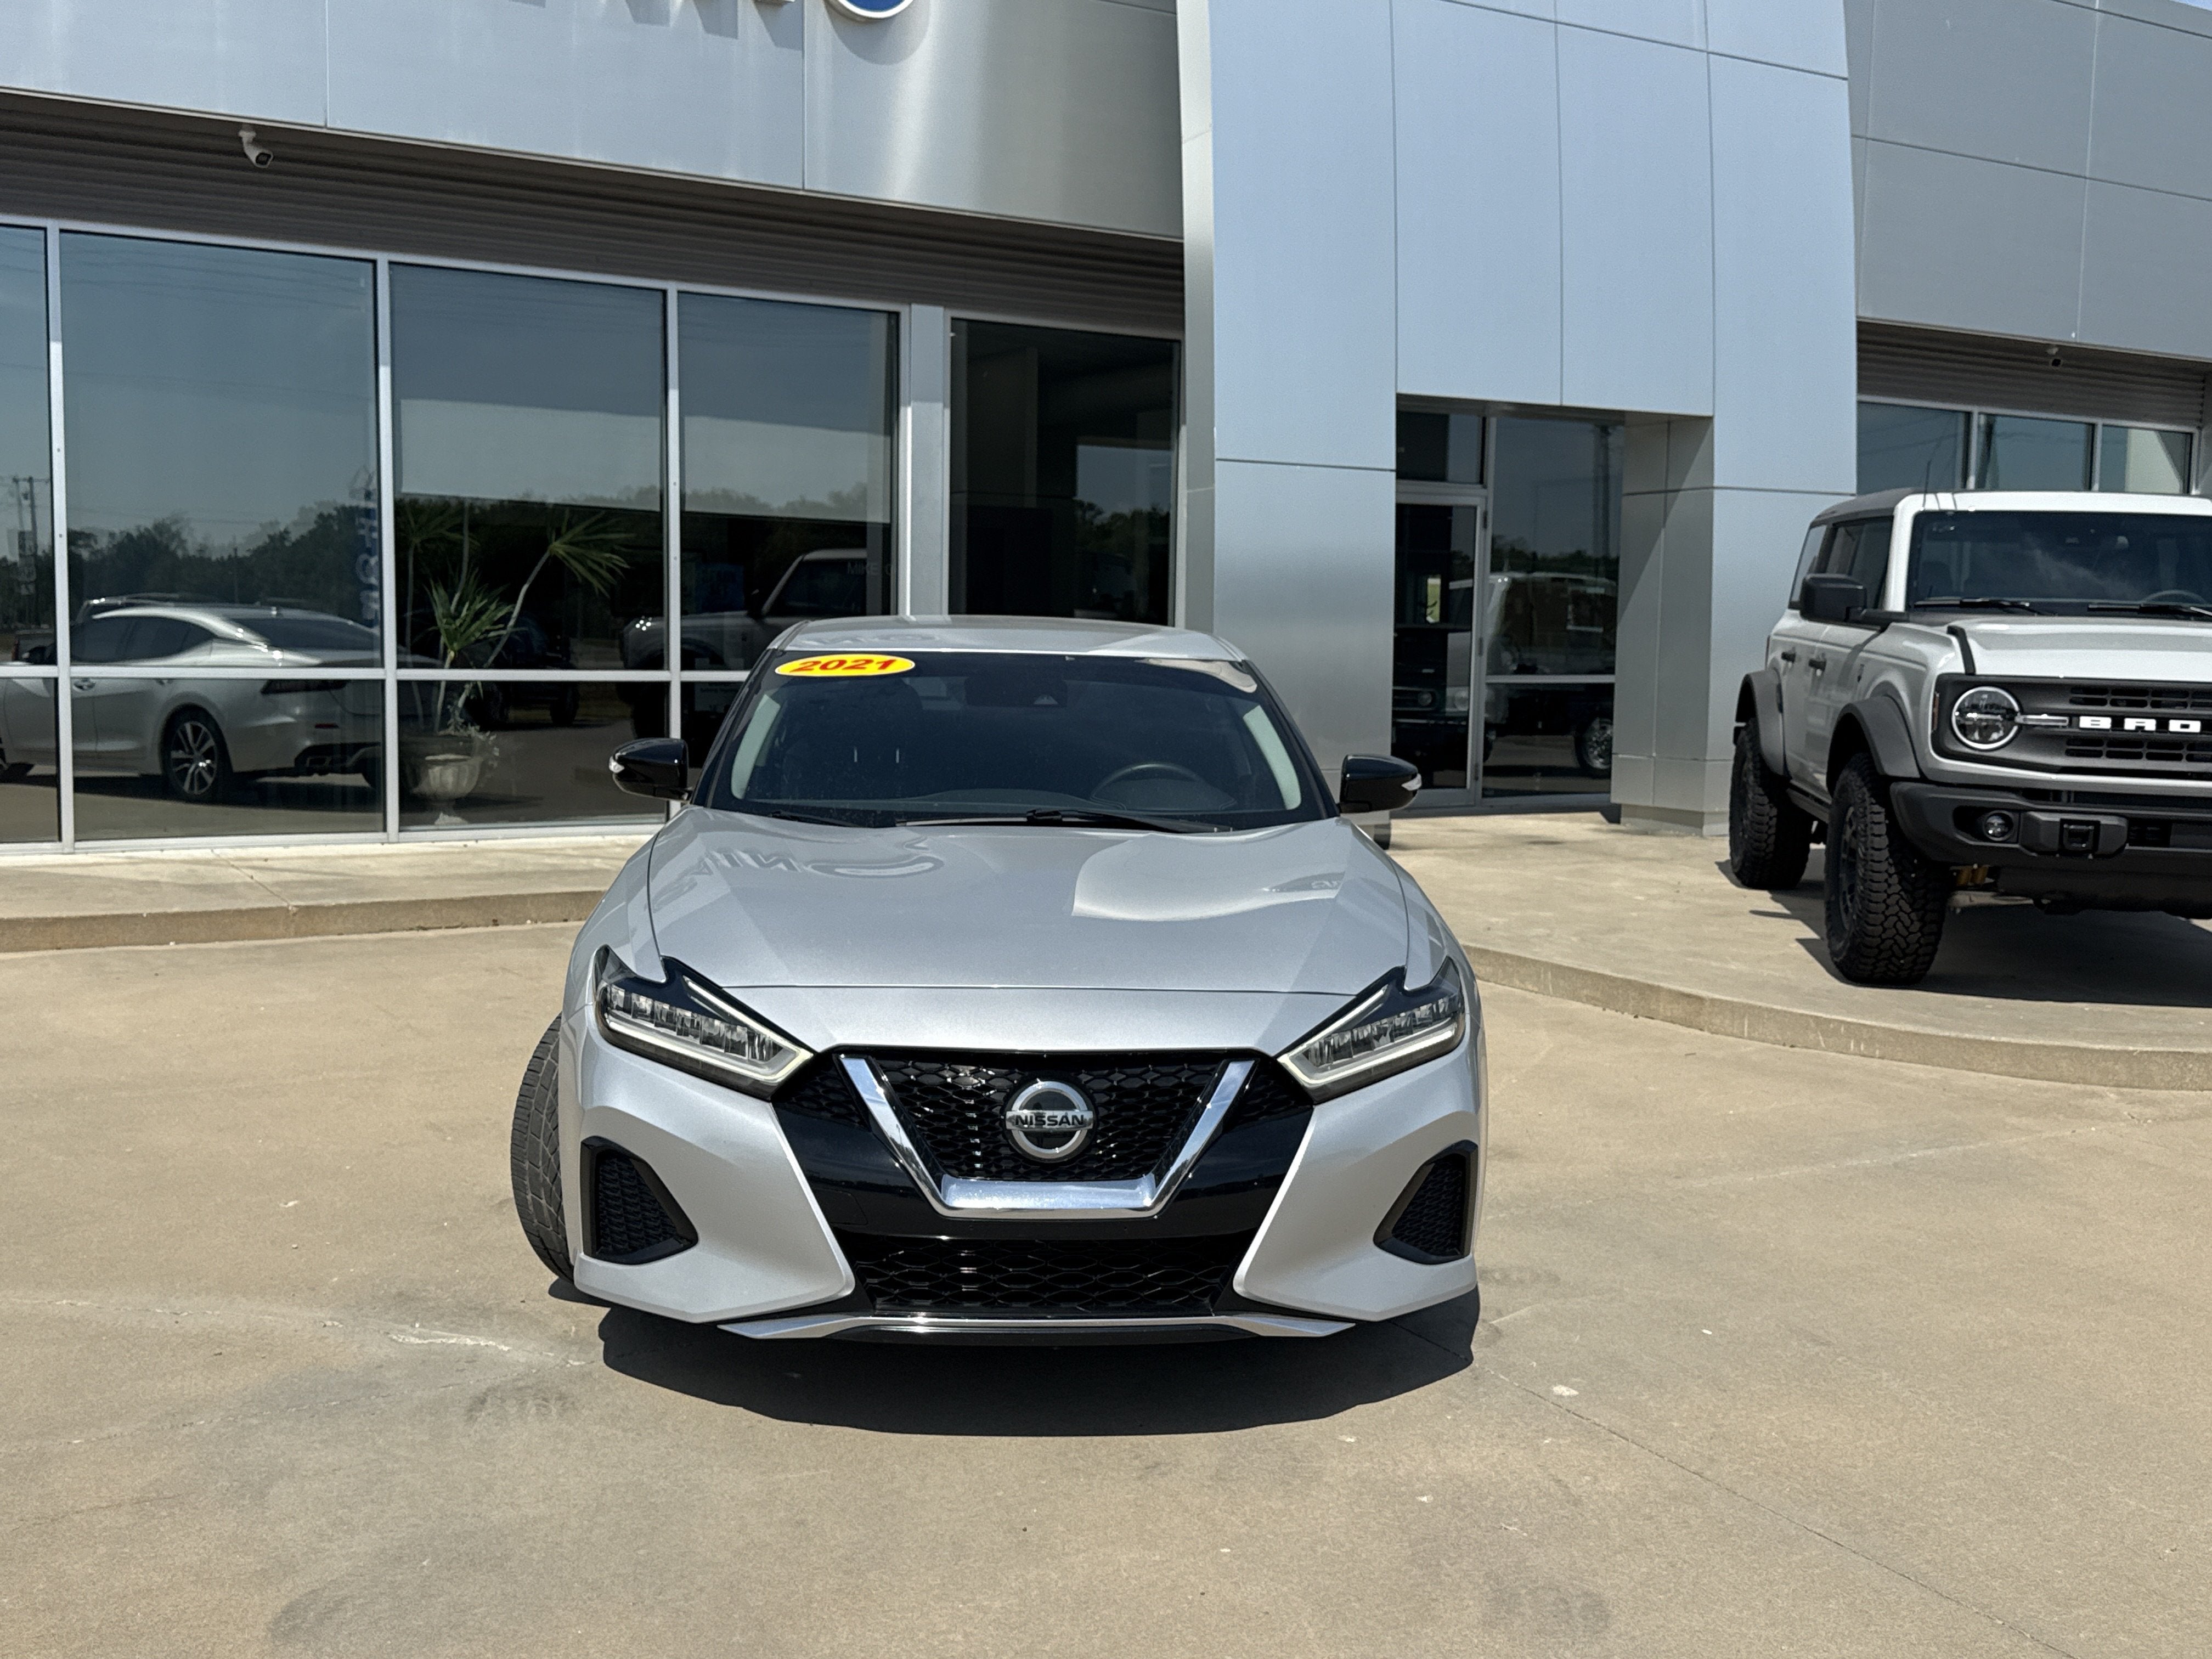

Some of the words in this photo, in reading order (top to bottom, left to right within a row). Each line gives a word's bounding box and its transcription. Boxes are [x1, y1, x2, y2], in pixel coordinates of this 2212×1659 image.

[788, 659, 897, 673] 2021
[2079, 715, 2201, 733] BRO
[1015, 1114, 1085, 1126] NISSAN
